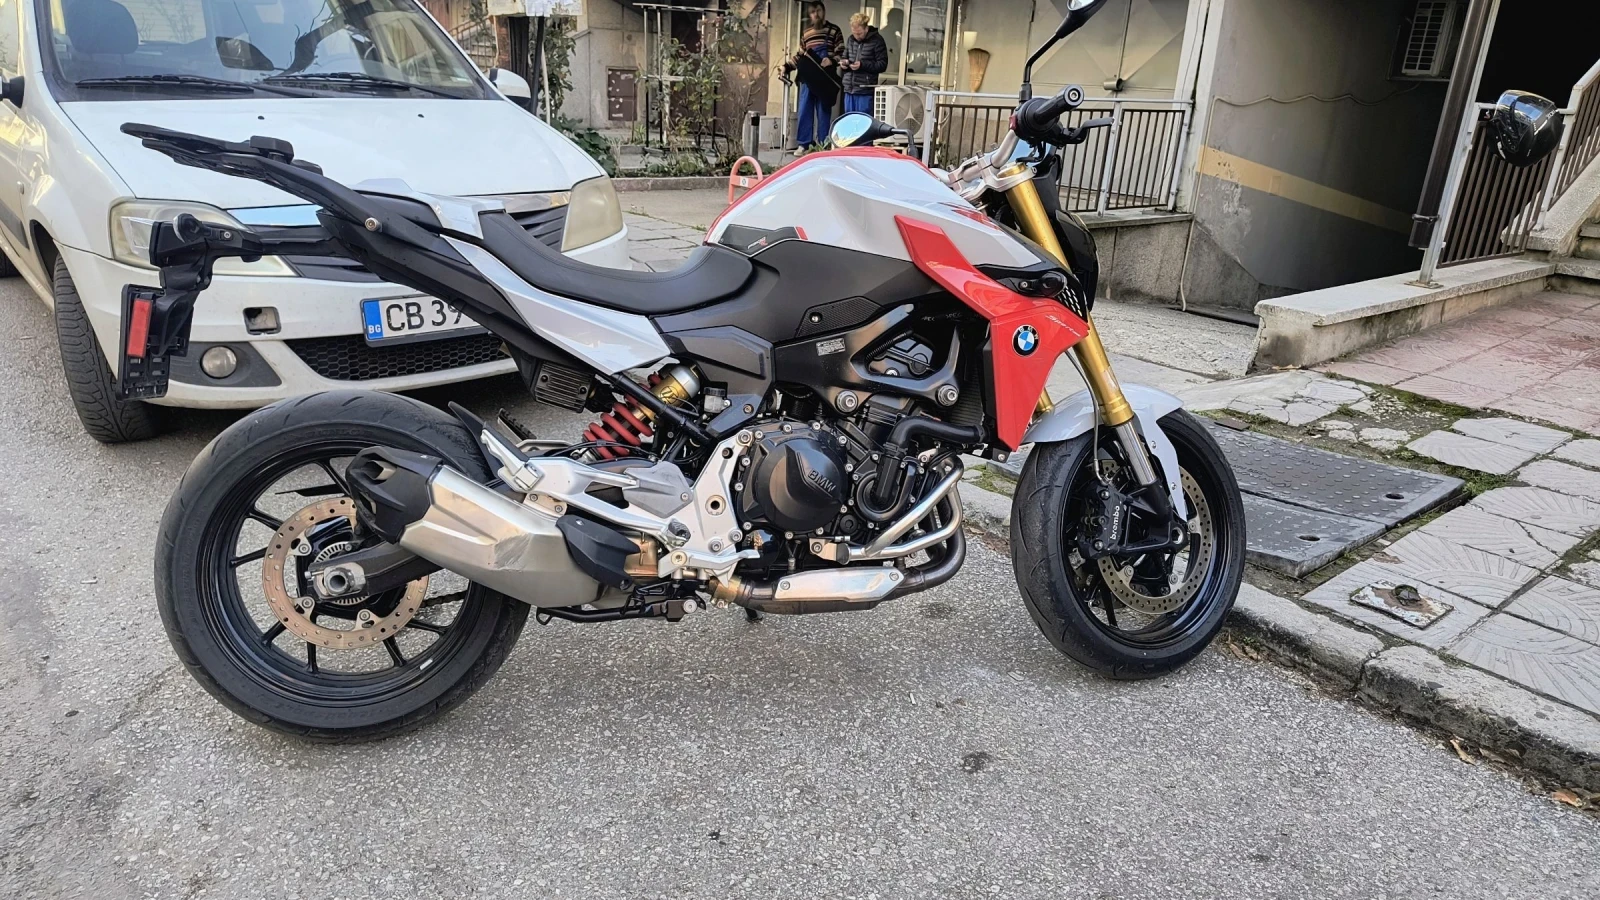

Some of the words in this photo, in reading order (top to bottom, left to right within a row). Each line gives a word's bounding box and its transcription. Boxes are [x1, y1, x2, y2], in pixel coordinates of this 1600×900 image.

[386, 301, 425, 331] CB
[368, 324, 382, 334] BG
[1019, 326, 1039, 339] BMW
[808, 469, 836, 492] BMW
[1109, 505, 1121, 540] brembo
